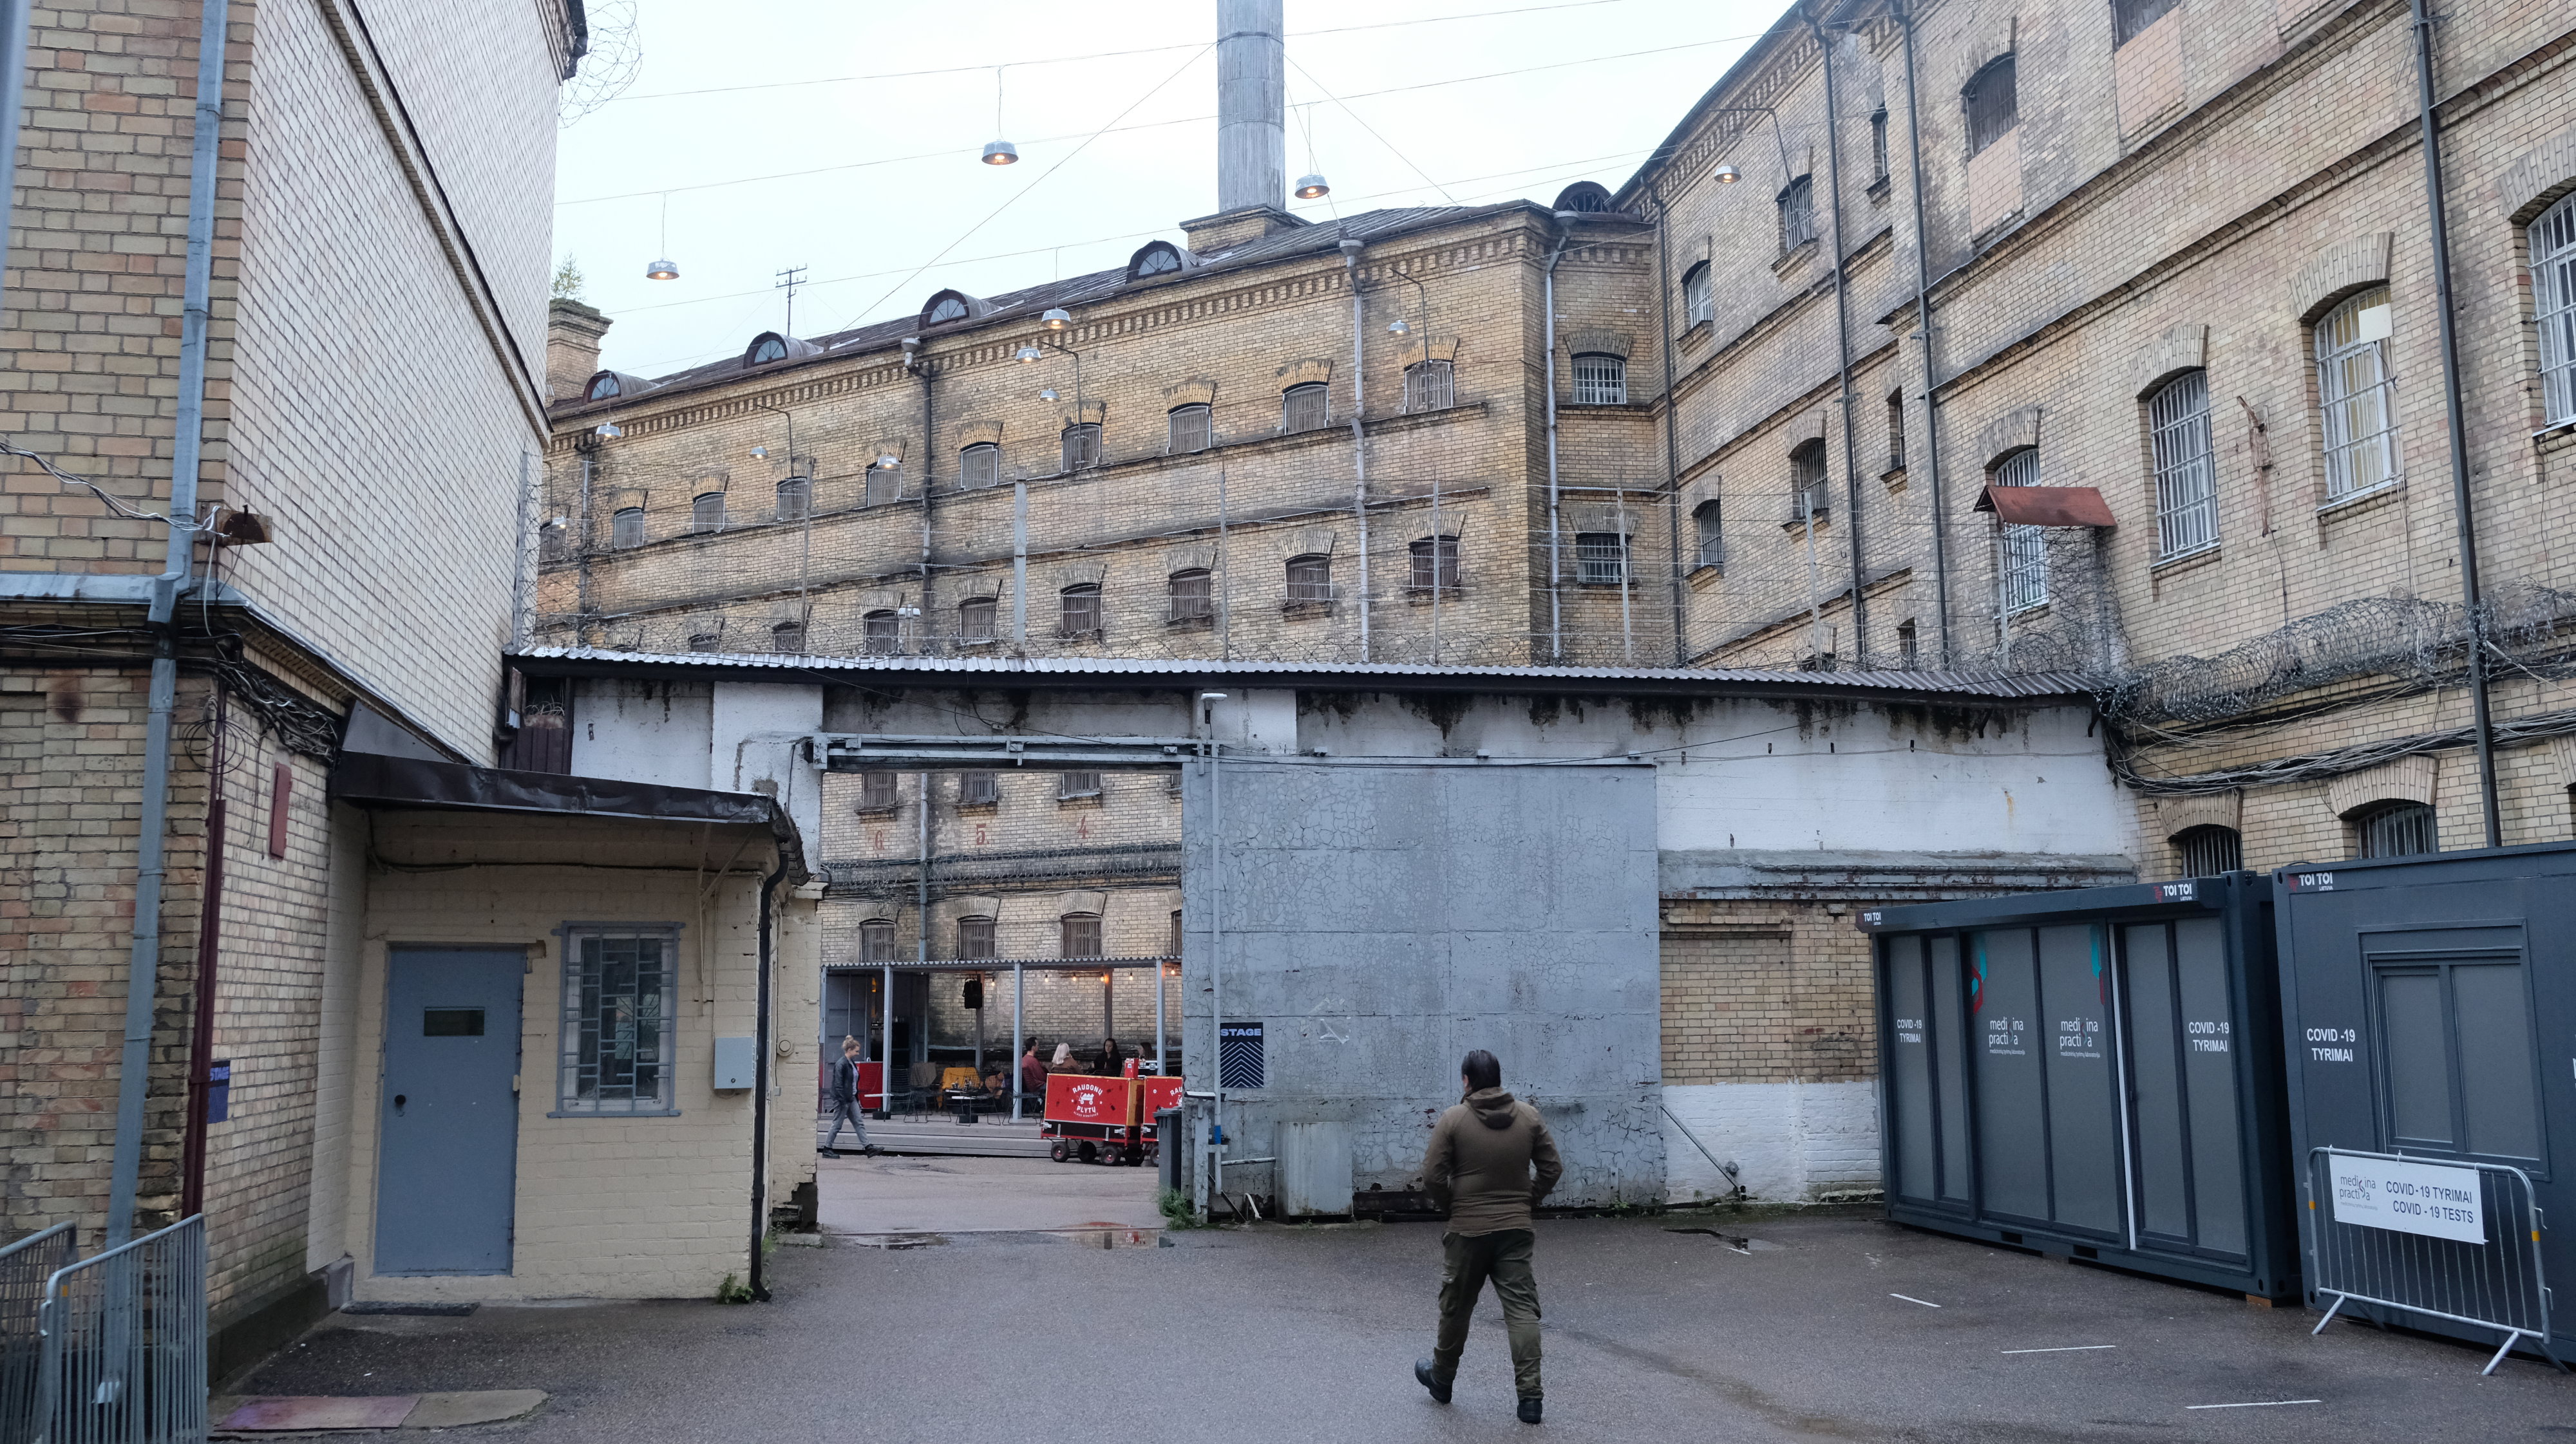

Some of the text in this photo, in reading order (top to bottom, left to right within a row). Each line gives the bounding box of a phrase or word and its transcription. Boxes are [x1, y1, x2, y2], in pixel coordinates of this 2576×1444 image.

[2299, 872, 2333, 886] TOI TOI
[2163, 883, 2192, 896] TOI TOI
[1873, 912, 1881, 921] TOI
[1897, 1019, 1913, 1029] COVID
[2189, 1022, 2215, 1034] COVID
[1220, 1028, 1262, 1036] STAGE
[1900, 1033, 1920, 1043] TYRIMAI
[2307, 1028, 2338, 1041] COVID
[2193, 1040, 2228, 1052] TYRIMAI
[2311, 1048, 2353, 1062] TYRIMAI
[2432, 1186, 2472, 1204] TYRIMAI
[2393, 1200, 2421, 1215] COVID
[2443, 1207, 2474, 1223] TESTS
